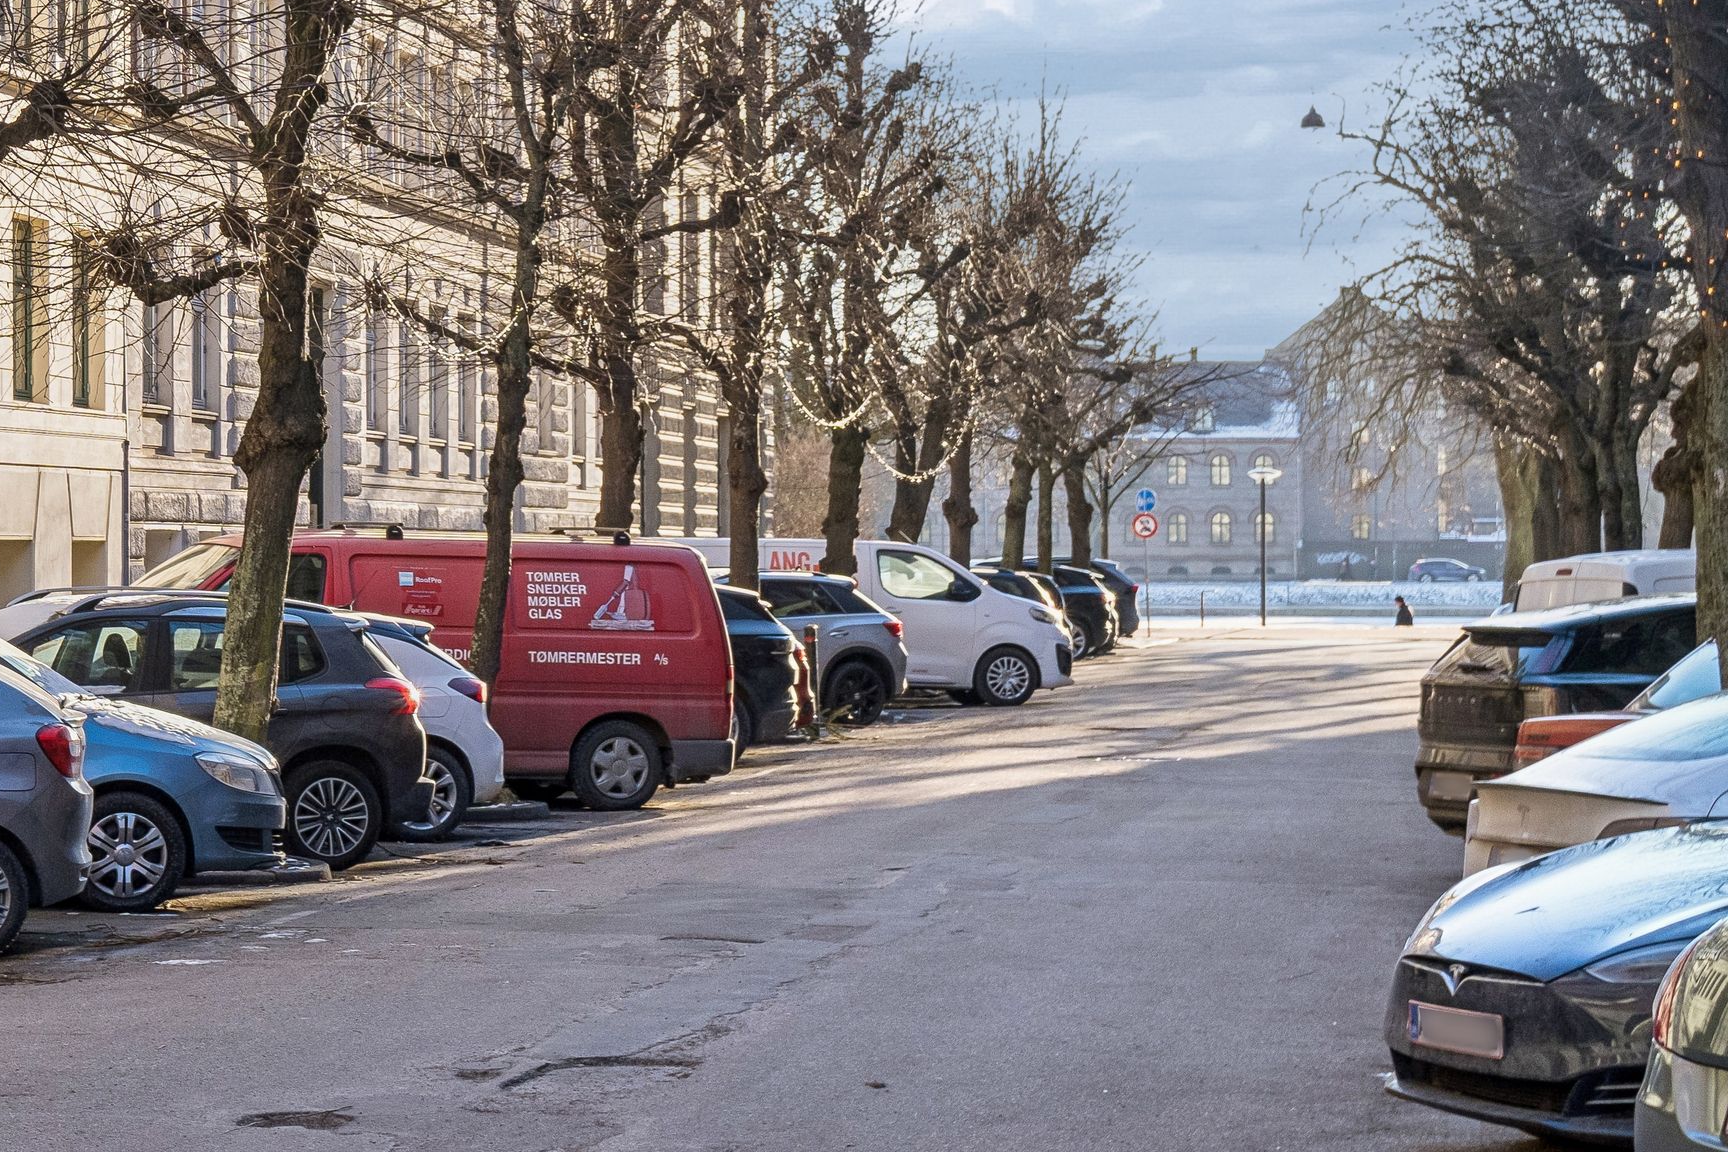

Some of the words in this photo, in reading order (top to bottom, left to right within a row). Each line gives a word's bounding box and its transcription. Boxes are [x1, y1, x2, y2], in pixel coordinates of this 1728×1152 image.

[525, 571, 580, 583] TØMRER
[526, 583, 587, 595] SNEDKER
[527, 595, 581, 607] MØBLER
[528, 608, 563, 619] GLAS
[528, 651, 641, 665] TØMRERMESTER
[654, 653, 669, 665] A/S
